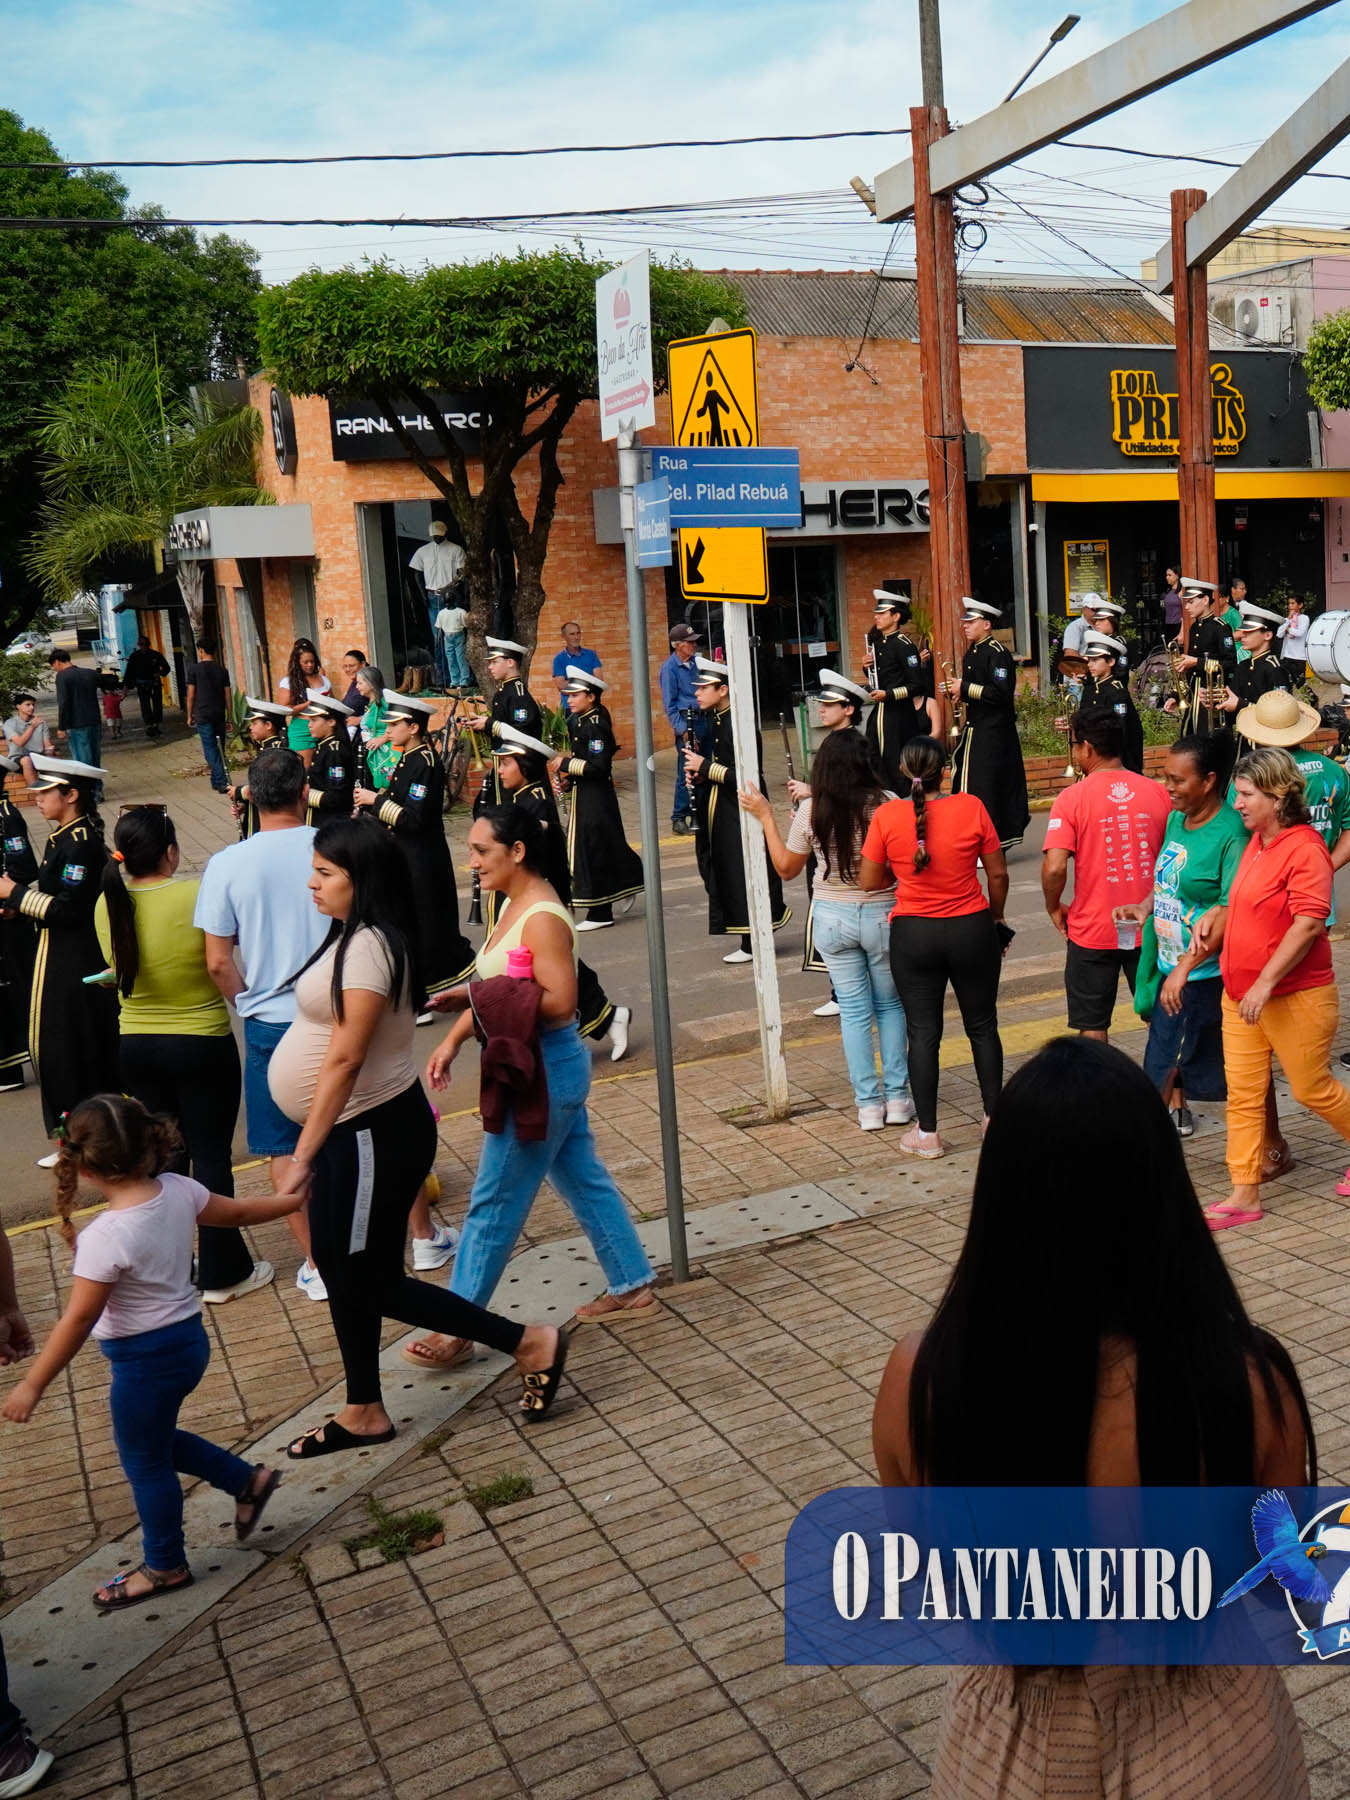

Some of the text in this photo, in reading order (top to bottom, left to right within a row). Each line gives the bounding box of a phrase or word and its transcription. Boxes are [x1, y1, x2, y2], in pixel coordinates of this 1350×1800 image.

[1115, 373, 1157, 396] LOJA
[1118, 396, 1244, 440] PRIUS
[1125, 442, 1174, 453] Utilidades
[659, 456, 688, 470] Rua
[696, 484, 735, 500] Pilad
[740, 484, 789, 500] Rebuá
[362, 1152, 373, 1178] RMC
